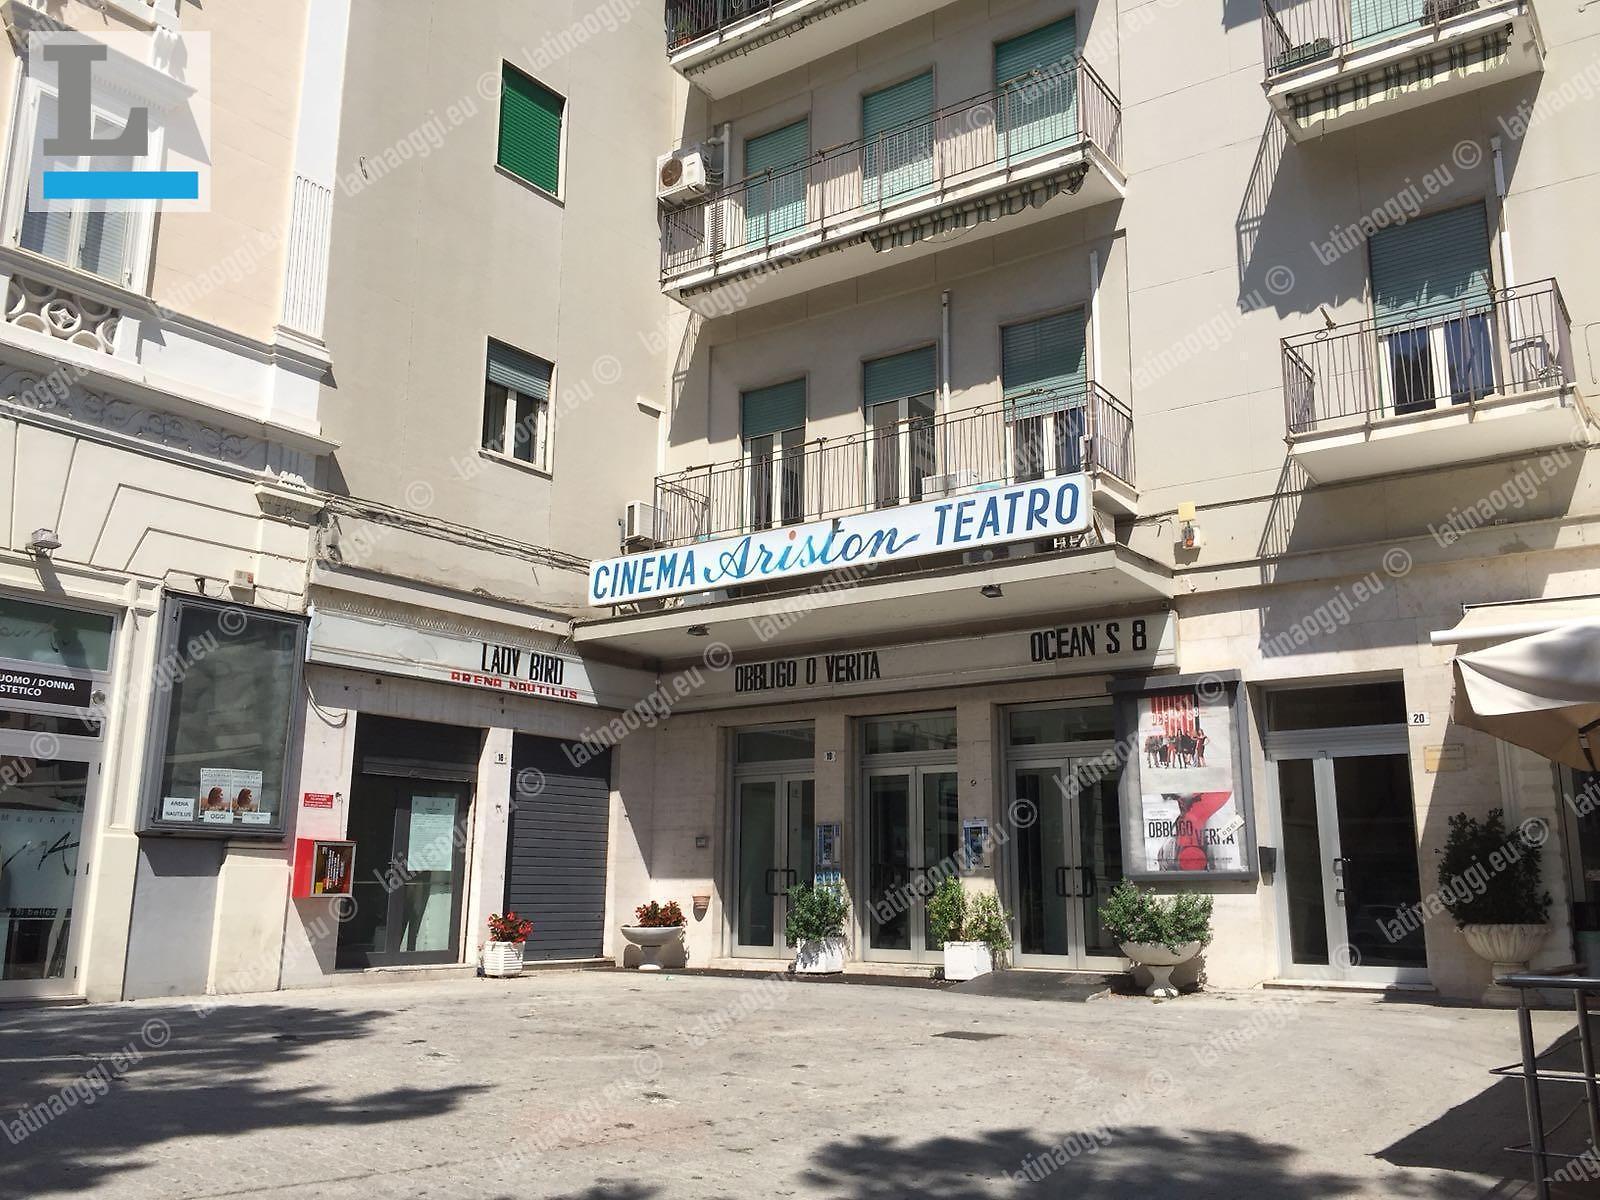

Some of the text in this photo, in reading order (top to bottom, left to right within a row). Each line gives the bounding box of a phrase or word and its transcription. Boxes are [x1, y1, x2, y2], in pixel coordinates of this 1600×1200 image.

[593, 482, 1080, 599] CINEMA Ariston TEATRO
[1132, 619, 1147, 651] 8
[481, 643, 564, 685] LADY BIRD
[735, 651, 881, 693] OBBLIGO O VERITA
[38, 679, 76, 691] DONNA
[451, 671, 577, 700] ARENA NAUTILUS
[1413, 713, 1425, 723] 20
[1148, 820, 1193, 838] OBBLIGO
